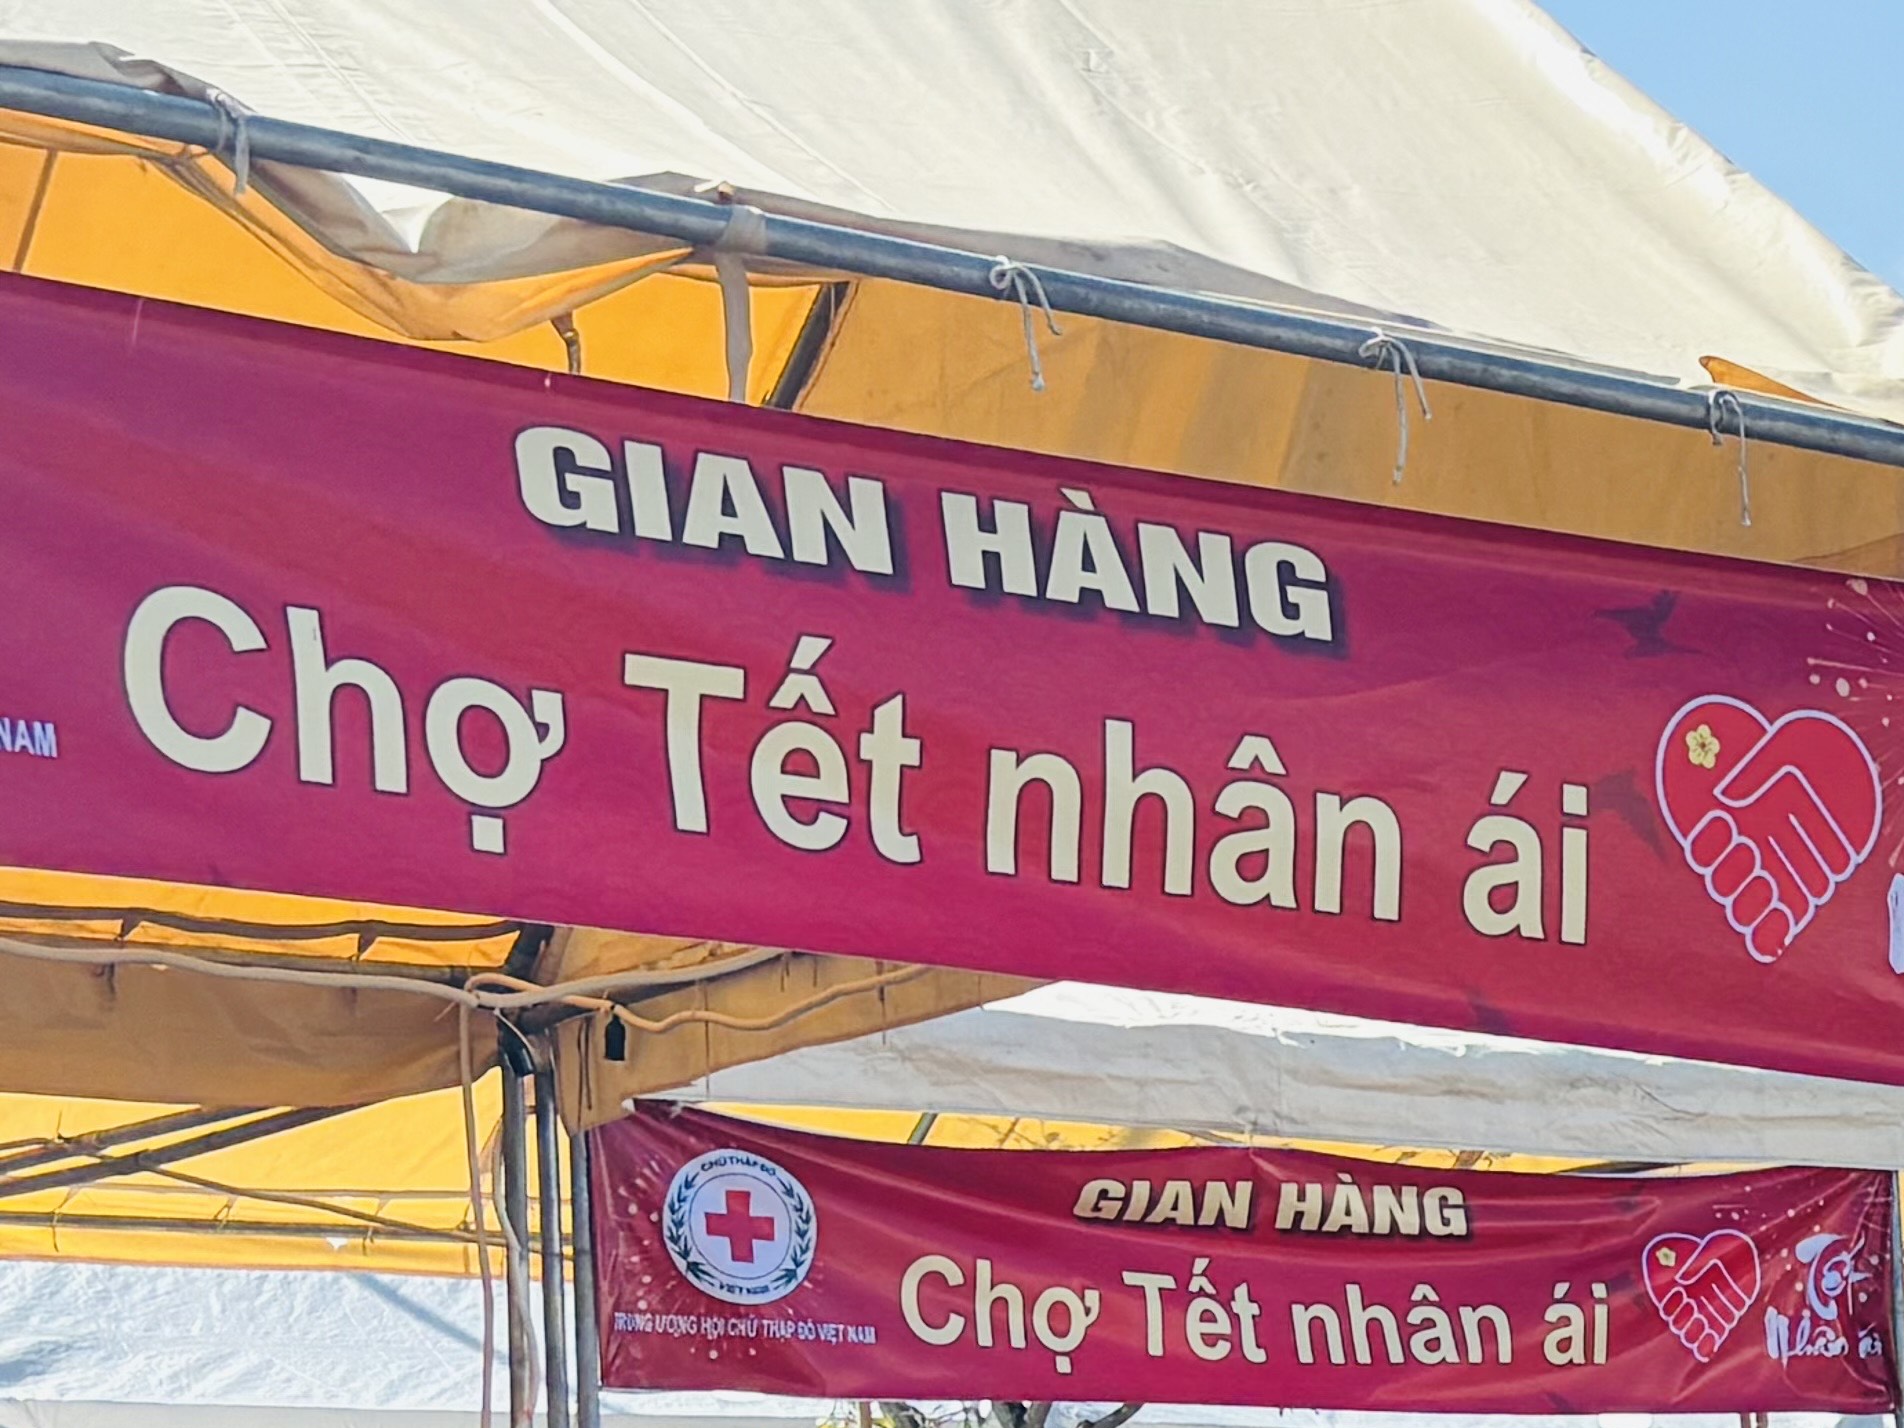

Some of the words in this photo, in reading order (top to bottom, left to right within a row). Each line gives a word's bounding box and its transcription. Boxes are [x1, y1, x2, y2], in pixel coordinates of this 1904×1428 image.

[513, 424, 895, 576] GIAN
[941, 487, 1335, 643] HÀNG
[123, 585, 565, 854] Chợ
[624, 635, 921, 864] Tết
[985, 718, 1401, 923] nhân
[1463, 770, 1589, 945] ái
[1073, 1177, 1250, 1228] GIAN
[1274, 1174, 1468, 1238] HÀNG
[900, 1254, 1101, 1374] Chợ
[1122, 1256, 1268, 1364] Tết
[1291, 1281, 1512, 1365] nhân
[1541, 1281, 1610, 1365] ái
